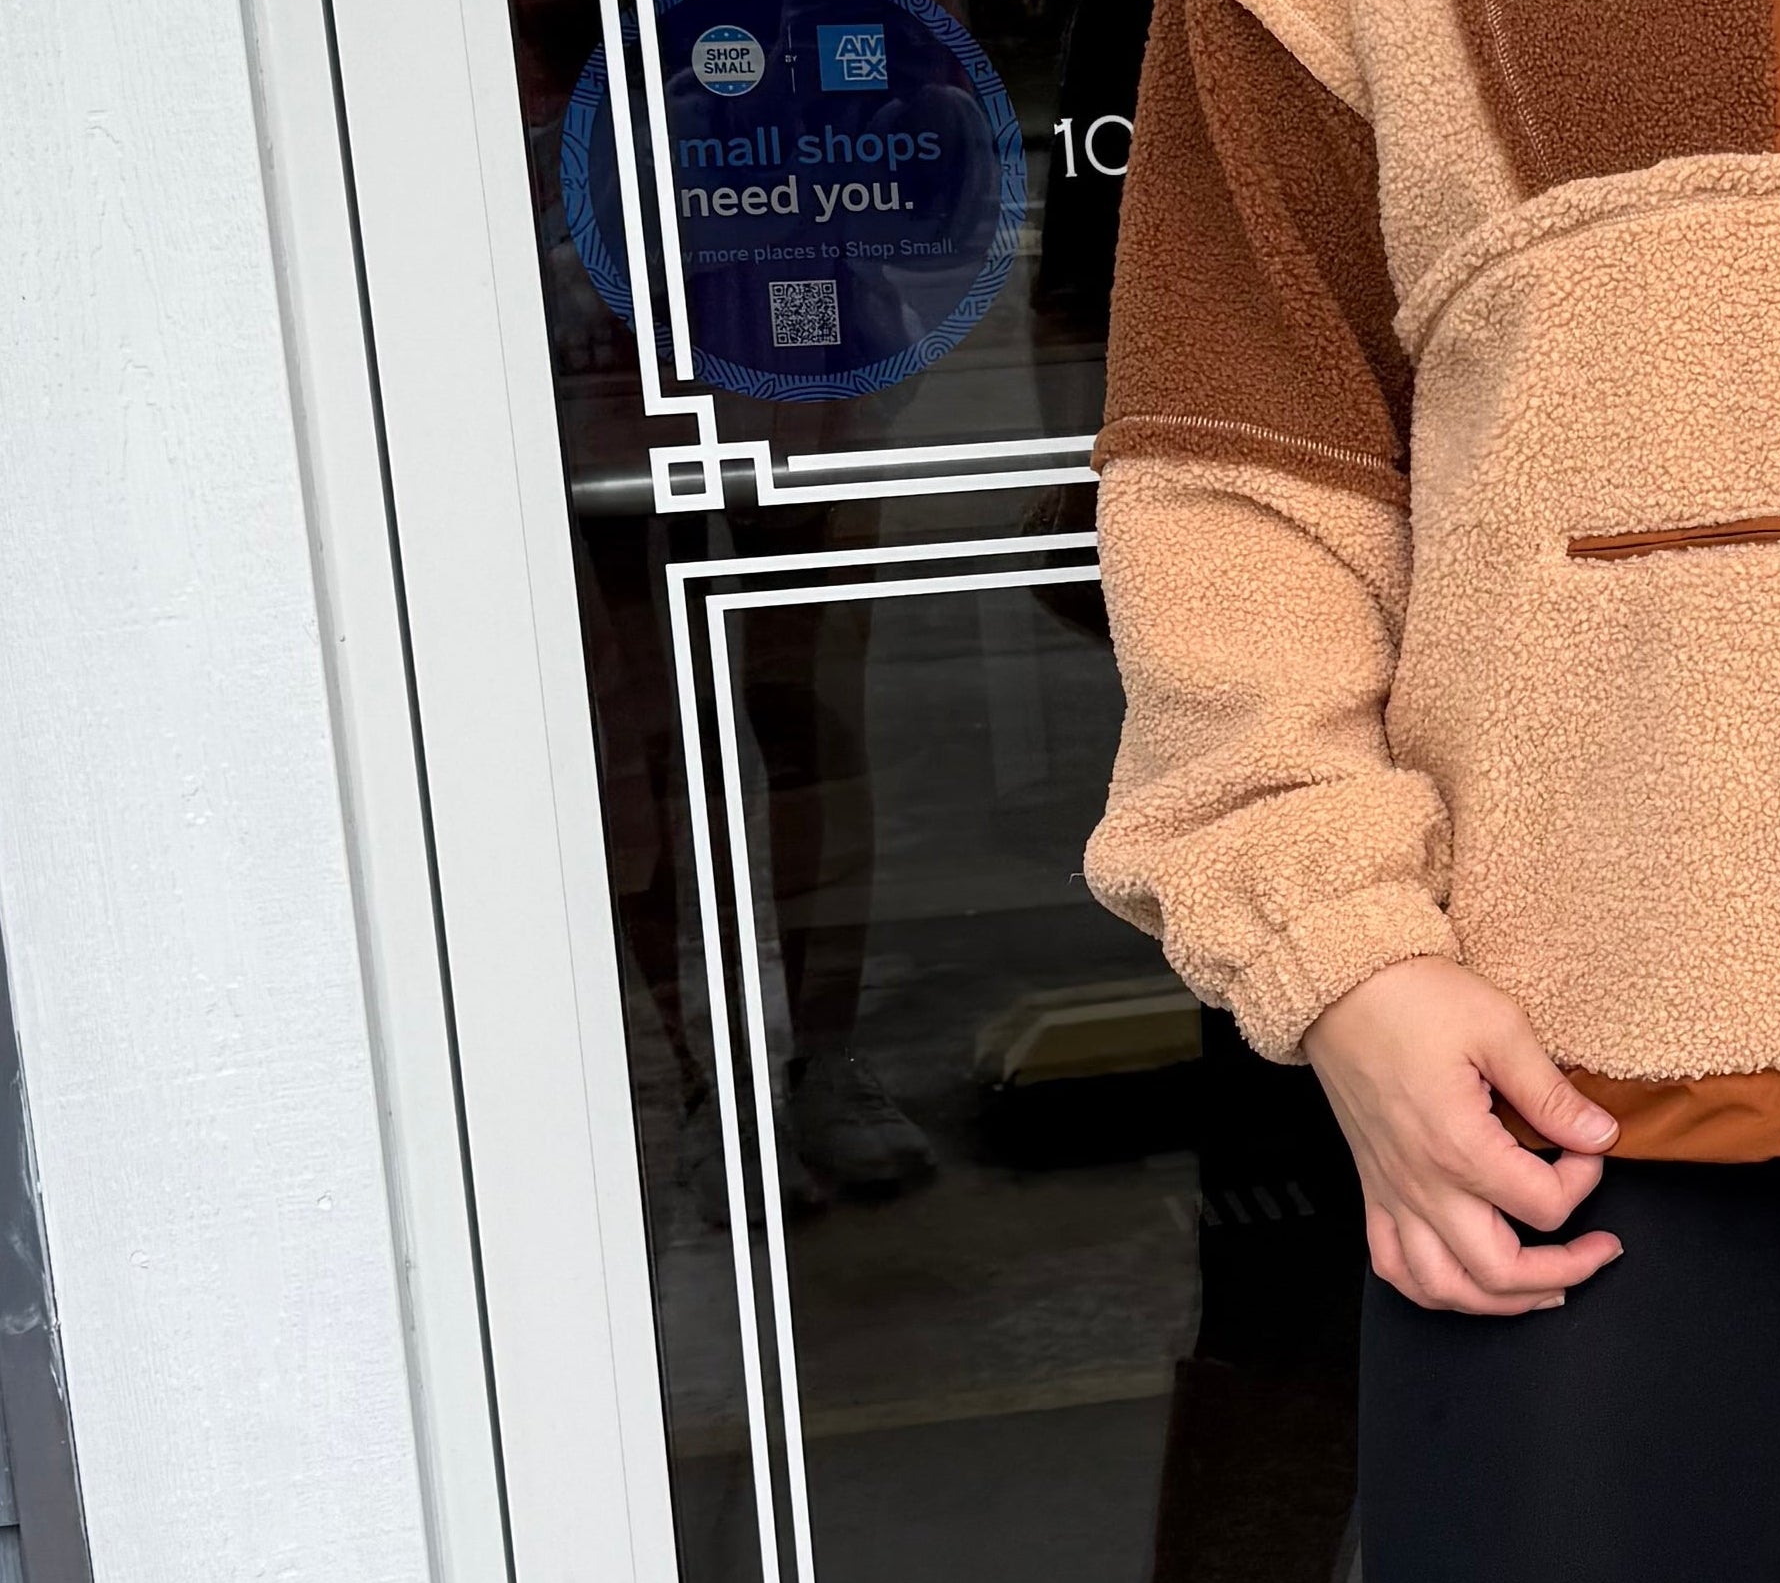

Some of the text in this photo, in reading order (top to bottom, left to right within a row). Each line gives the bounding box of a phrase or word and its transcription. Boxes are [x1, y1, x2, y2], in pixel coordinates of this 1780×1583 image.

[705, 48, 750, 62] SHOP
[836, 34, 886, 60] AM
[703, 61, 756, 75] SMALL
[843, 58, 888, 81] EX
[664, 125, 942, 171] mall shops
[680, 174, 914, 223] need you.
[699, 248, 750, 263] more
[753, 243, 816, 265] places
[819, 244, 841, 259] to
[845, 241, 895, 261] Shop
[899, 239, 958, 256] Small.
